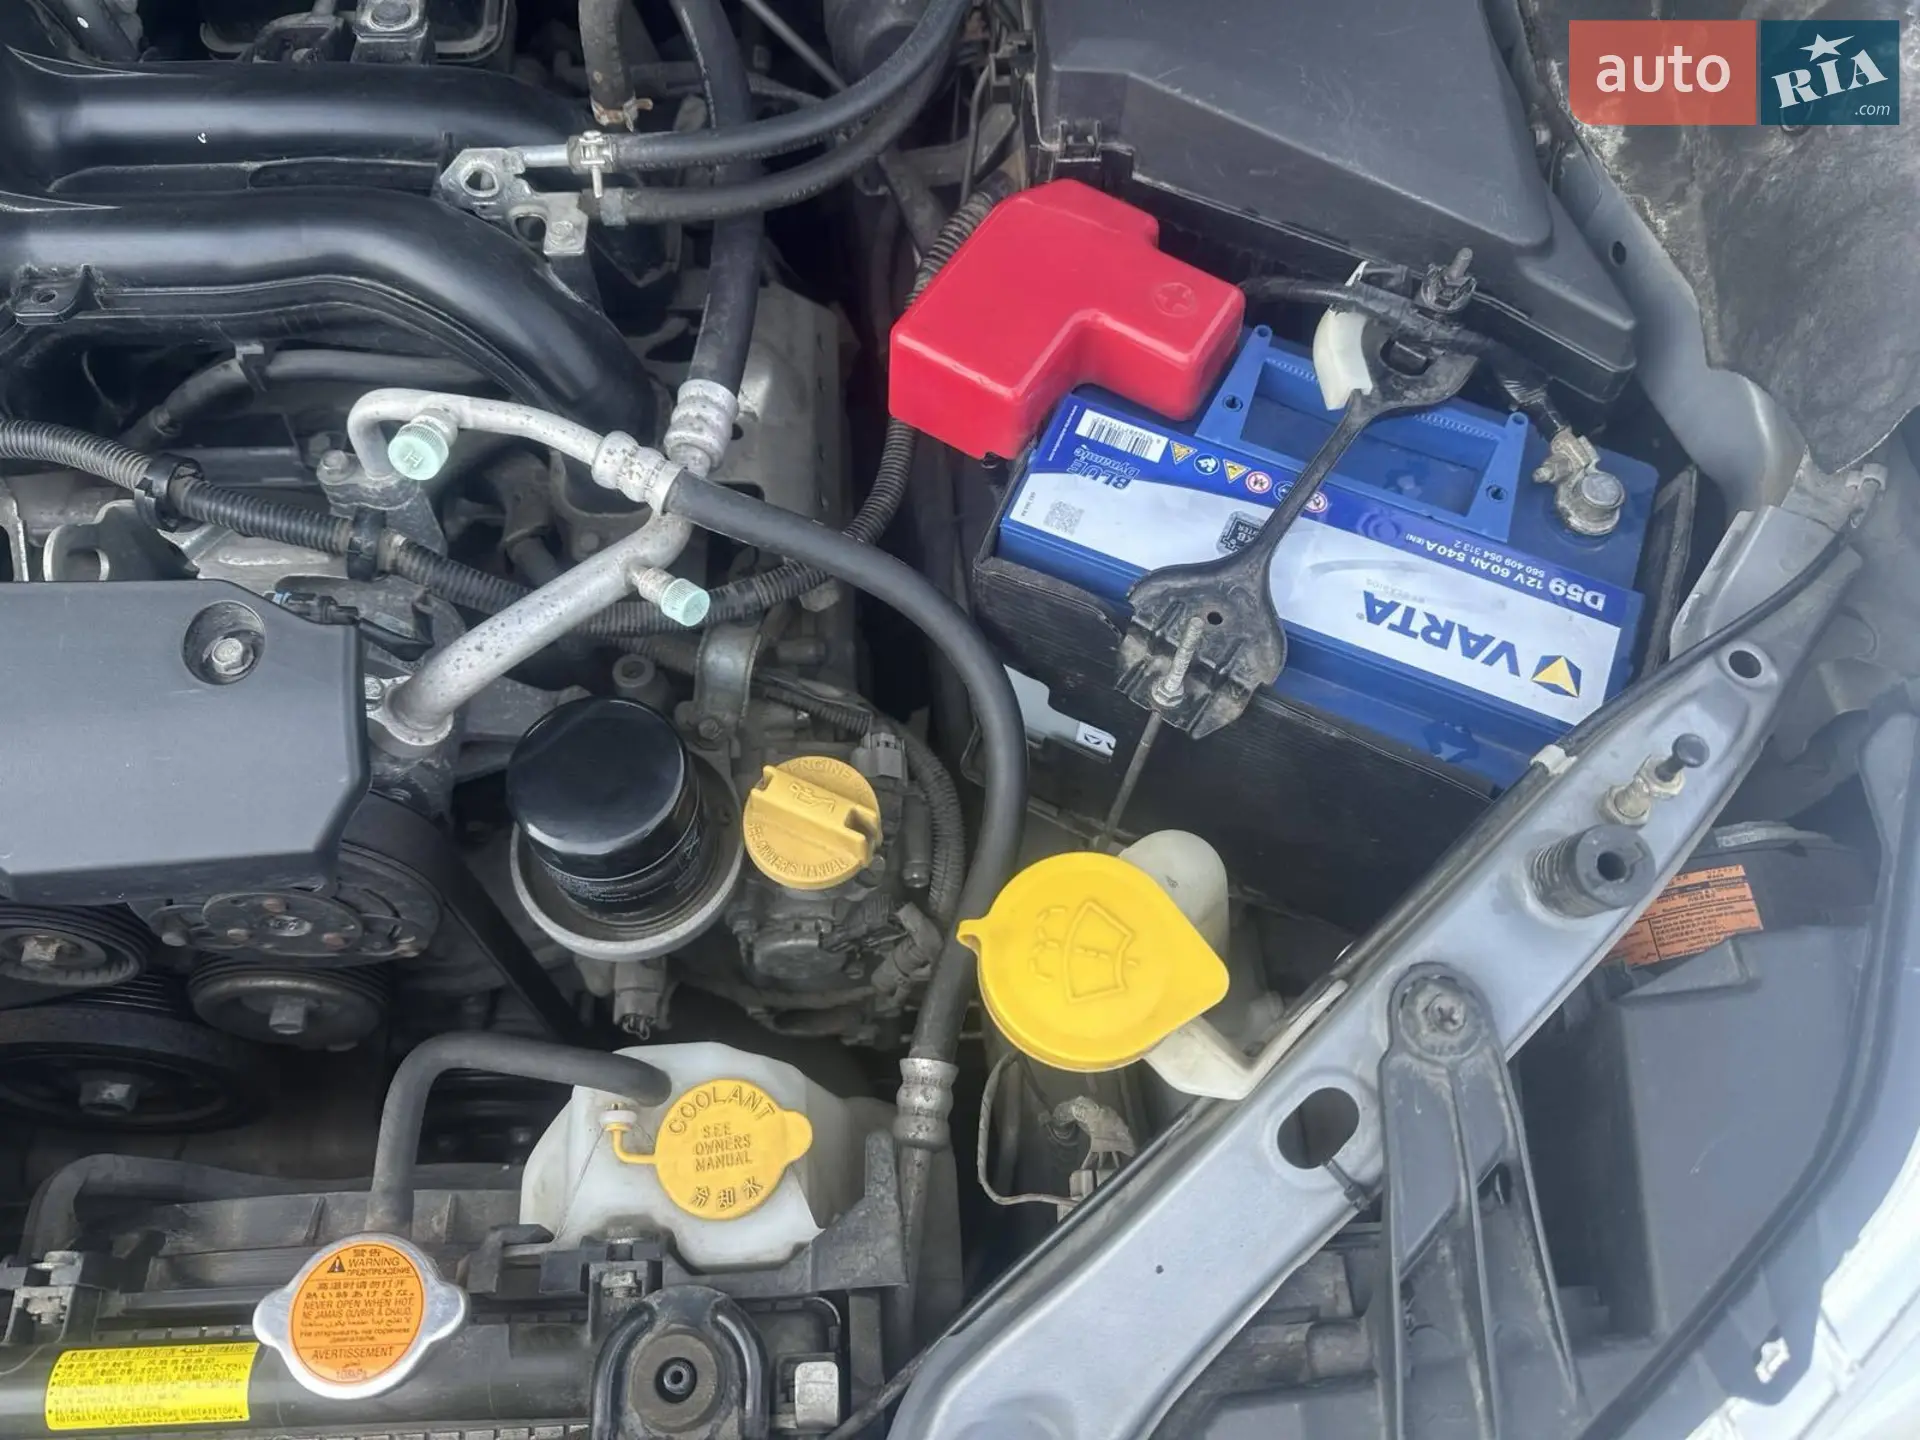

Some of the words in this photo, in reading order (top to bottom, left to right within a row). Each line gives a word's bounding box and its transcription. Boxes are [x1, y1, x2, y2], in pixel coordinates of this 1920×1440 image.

[1073, 445, 1140, 479] Dynamic
[1067, 458, 1134, 490] BLUE
[1462, 543, 1482, 555] 313
[1483, 550, 1503, 562] 054
[1469, 556, 1511, 578] 60Ah
[1513, 572, 1544, 590] 12V
[1549, 577, 1607, 611] D59
[1363, 589, 1520, 677] VARTA
[786, 759, 852, 779] ENGINE
[801, 858, 848, 878] MANUAL
[668, 1085, 776, 1134] COOLANT
[703, 1122, 731, 1138] SEE
[694, 1133, 751, 1155] OWNERS
[695, 1151, 753, 1172] MANUAL
[348, 1257, 400, 1267] WARNING
[303, 1301, 334, 1309] NEVER
[336, 1300, 362, 1309] OPEN
[364, 1299, 391, 1308] WHEN
[394, 1298, 414, 1307] HOT.
[311, 1347, 394, 1360] AVERTISSEMENT
